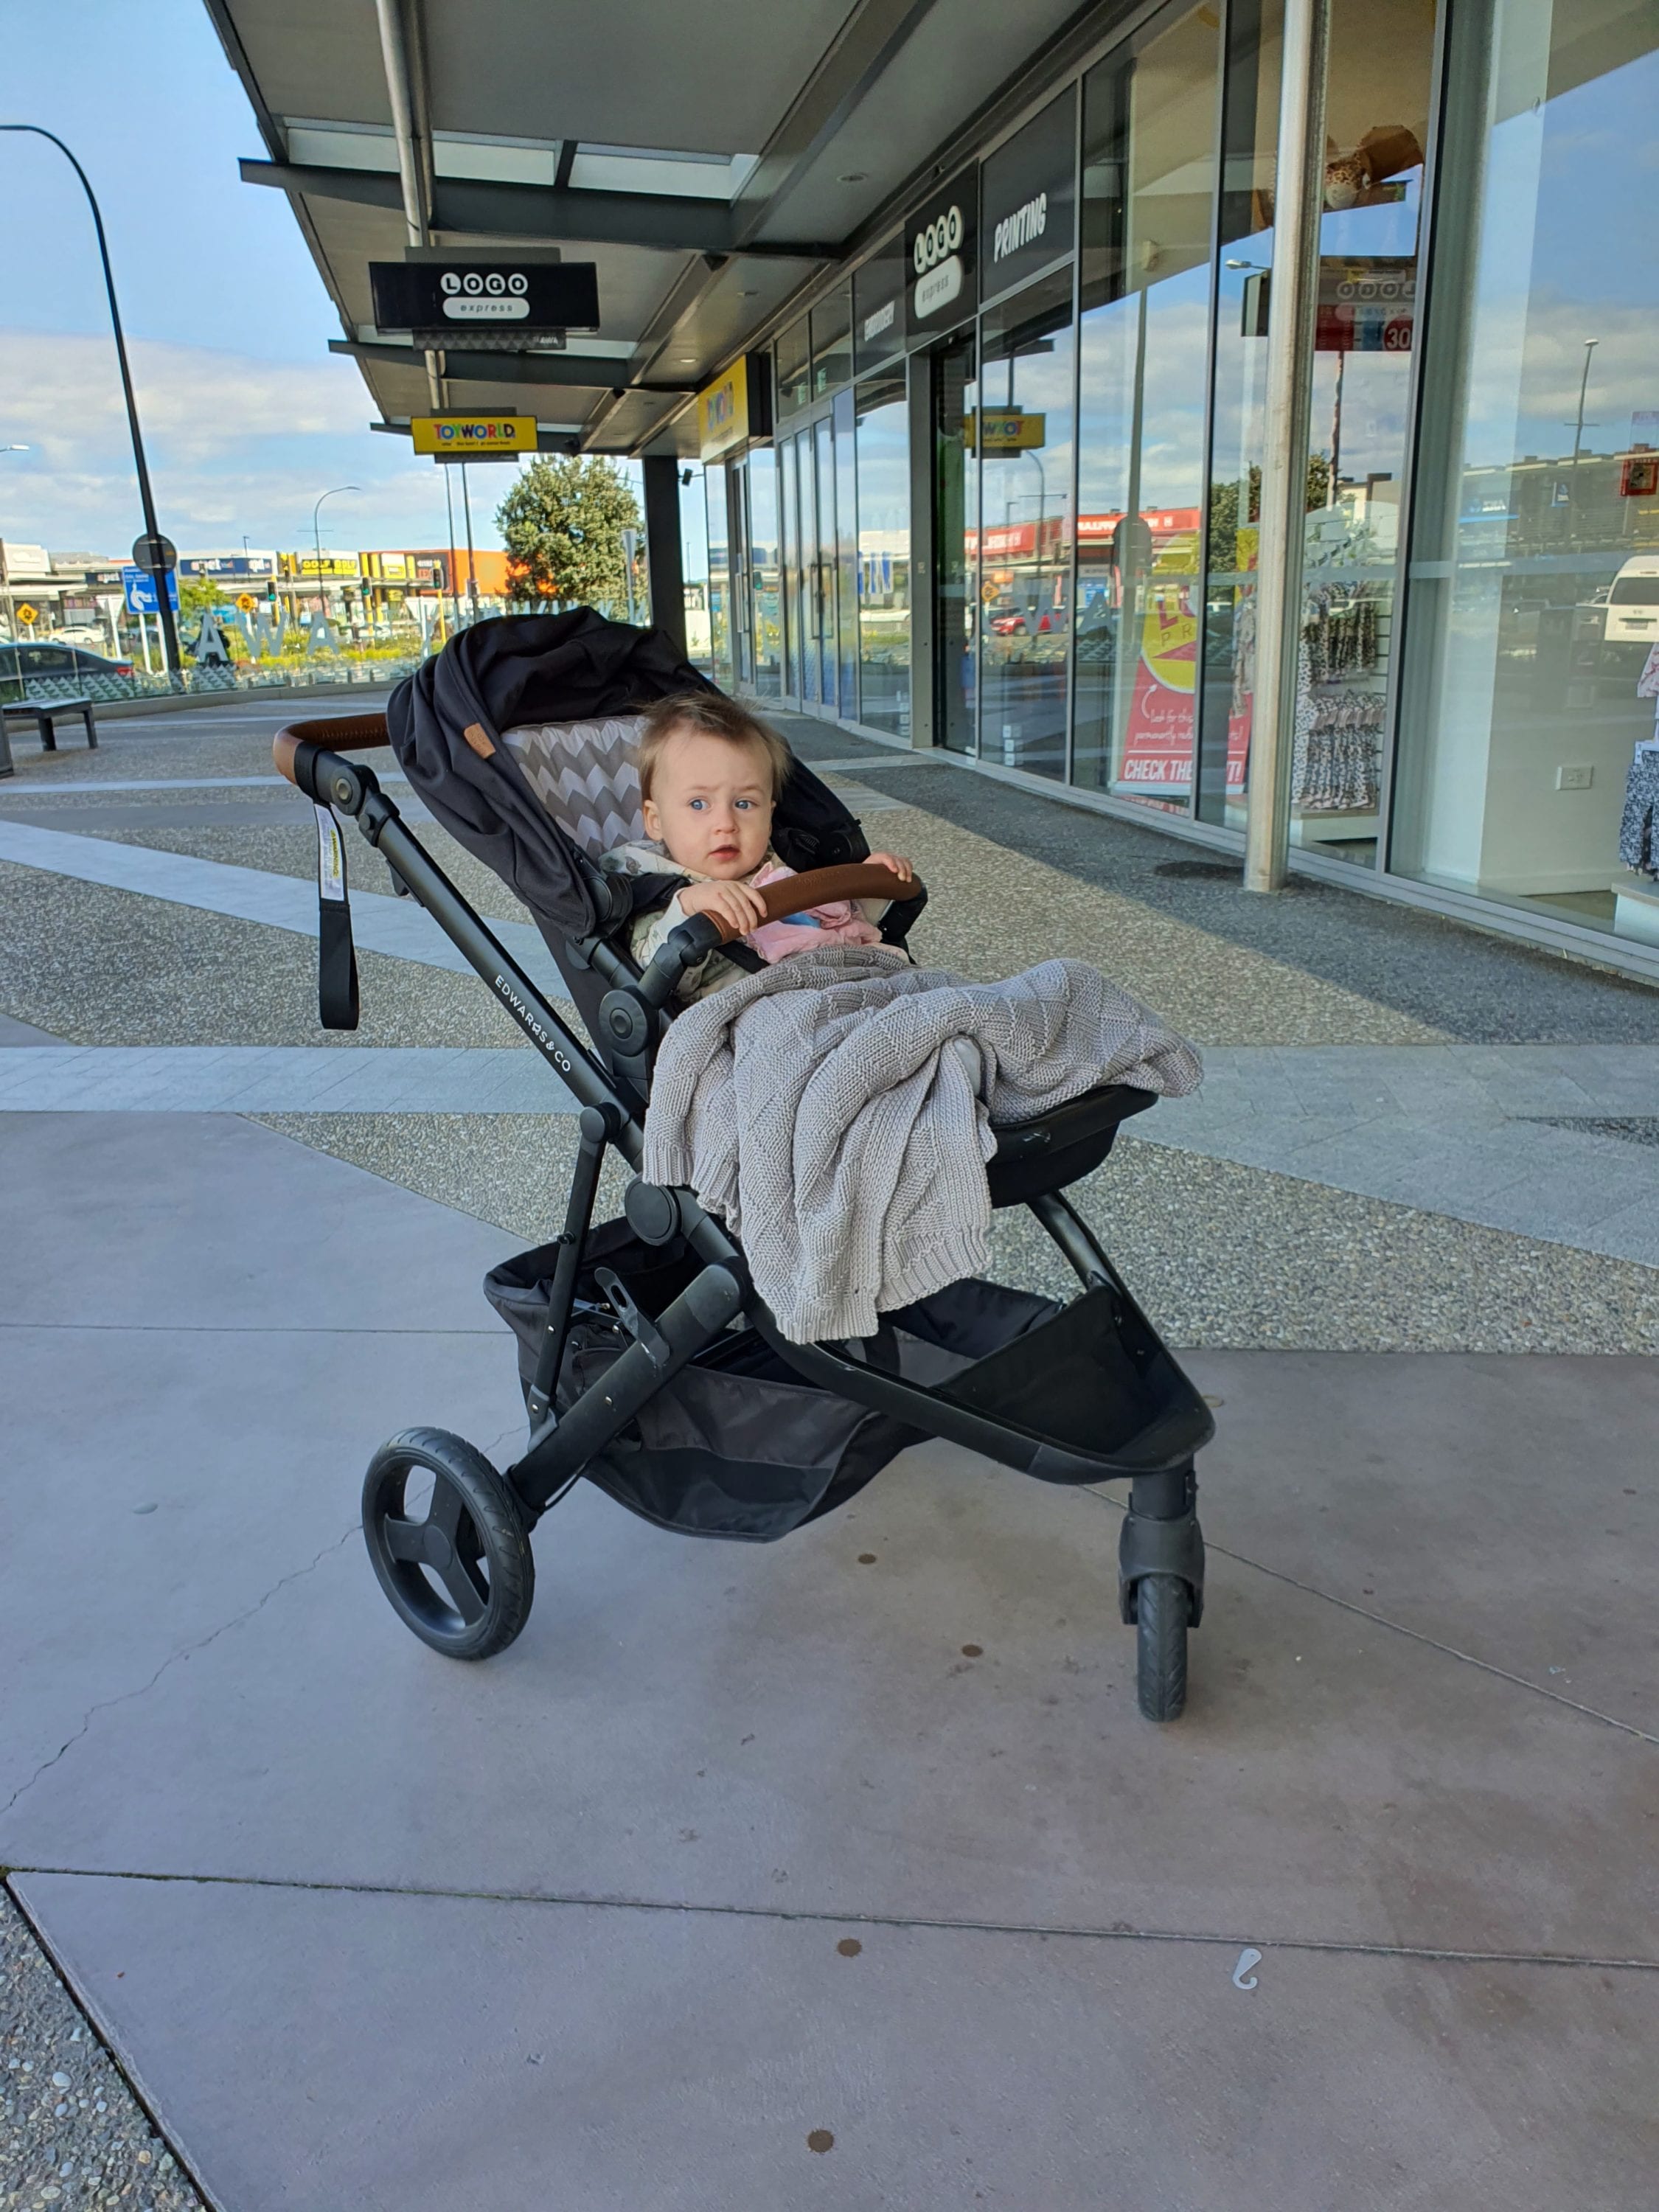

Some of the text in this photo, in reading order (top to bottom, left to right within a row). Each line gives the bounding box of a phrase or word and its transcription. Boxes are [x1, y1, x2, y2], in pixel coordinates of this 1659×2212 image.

[915, 207, 961, 271] LOGO
[994, 192, 1046, 264] PRINTING
[442, 274, 527, 293] LOGO
[460, 304, 513, 313] express
[1386, 327, 1411, 349] 30
[434, 423, 515, 440] TOYWORLD
[1124, 759, 1168, 781] CHECK
[1169, 760, 1192, 782] THE
[546, 1040, 555, 1051] &
[554, 1050, 571, 1072] CO
